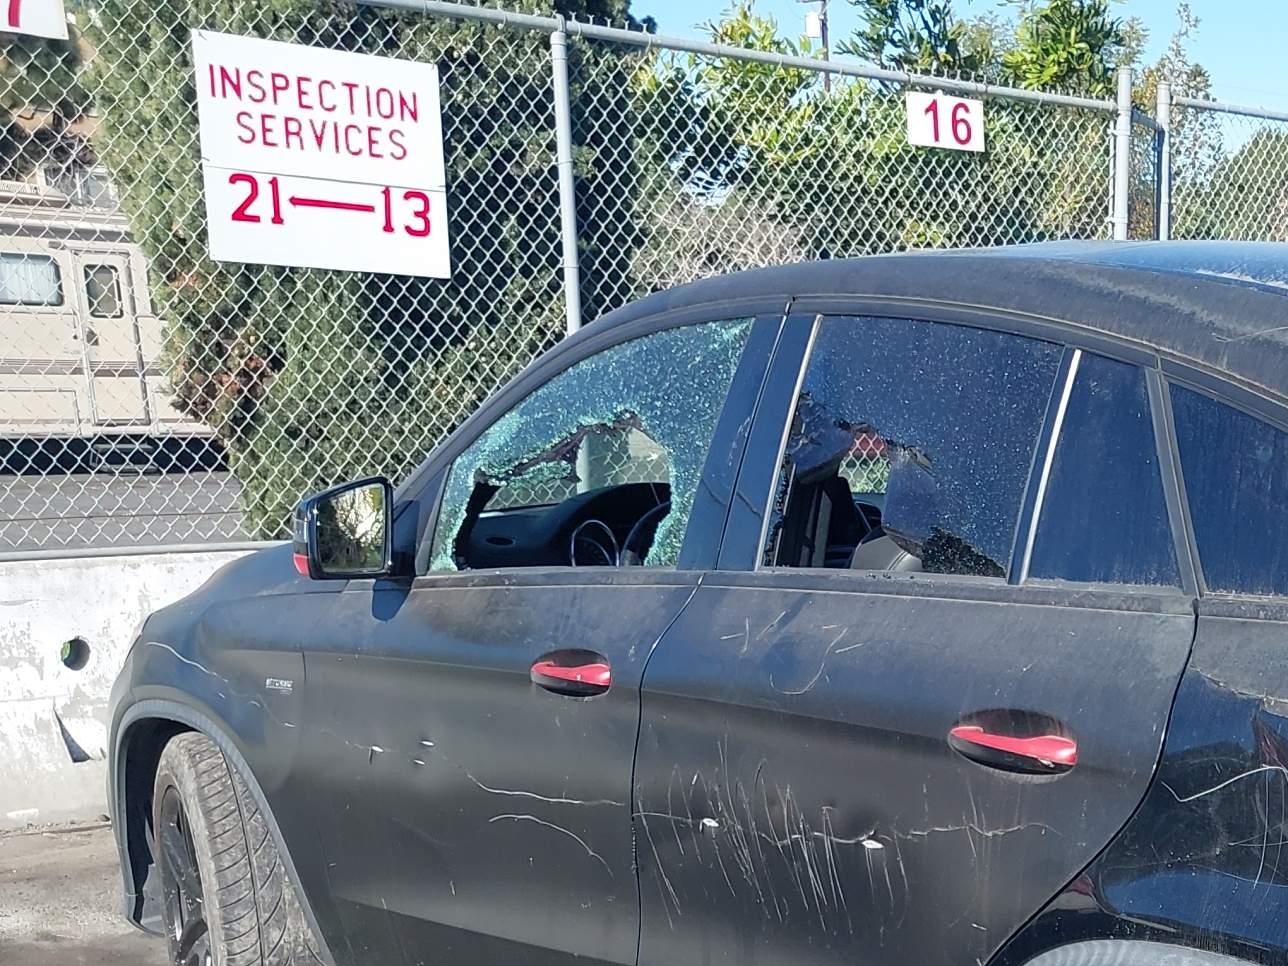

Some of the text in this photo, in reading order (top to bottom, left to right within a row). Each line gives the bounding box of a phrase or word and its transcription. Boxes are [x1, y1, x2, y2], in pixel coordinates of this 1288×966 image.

[208, 63, 419, 123] INSPECTION
[235, 111, 408, 160] SERVICES
[924, 98, 972, 146] 16
[228, 172, 431, 237] 21 13
